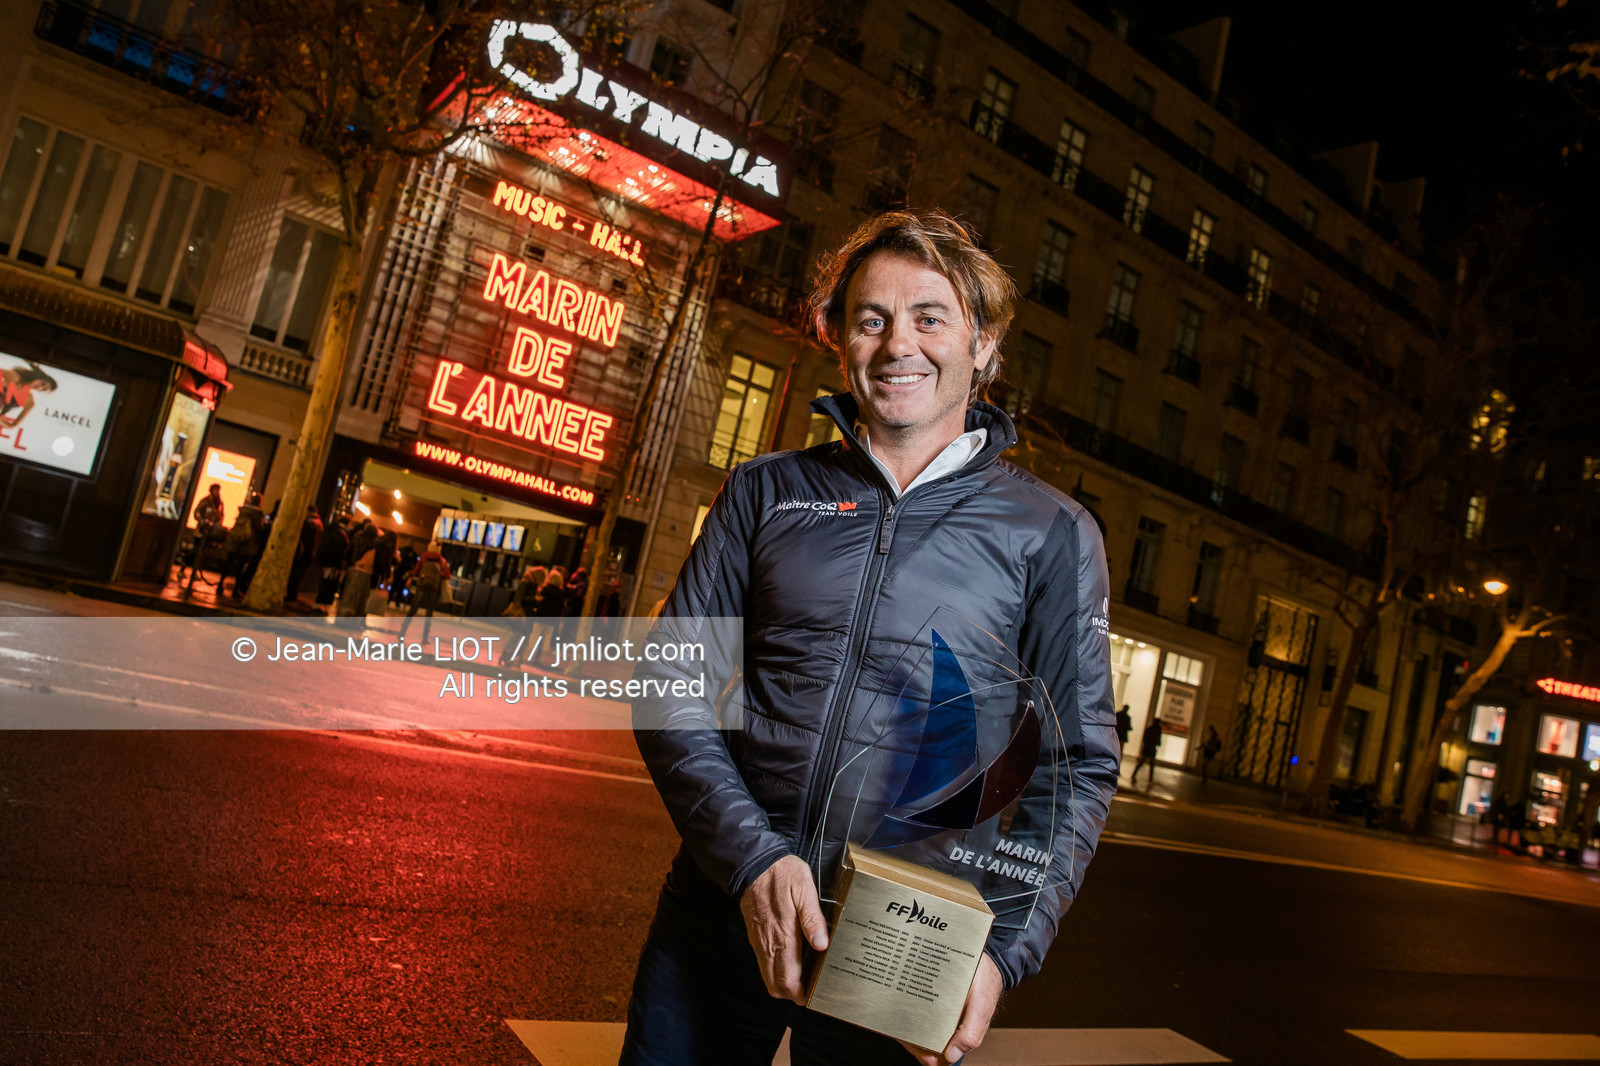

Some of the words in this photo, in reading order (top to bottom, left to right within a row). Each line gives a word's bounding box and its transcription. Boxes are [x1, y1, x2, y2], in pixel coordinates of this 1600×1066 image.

[487, 18, 781, 199] OLYMPIA
[492, 180, 567, 232] MUSIC
[589, 220, 646, 268] HALL
[483, 252, 625, 348] MARIN
[507, 325, 573, 390] DE
[44, 407, 92, 429] LANCEL
[427, 360, 614, 463] L'ANNEE
[415, 441, 595, 506] WWW.OLYMPIAHALL.COM
[776, 500, 811, 512] Maître
[949, 846, 974, 864] DE
[975, 855, 1048, 888] L’ANNÉE
[994, 838, 1055, 867] MARIN
